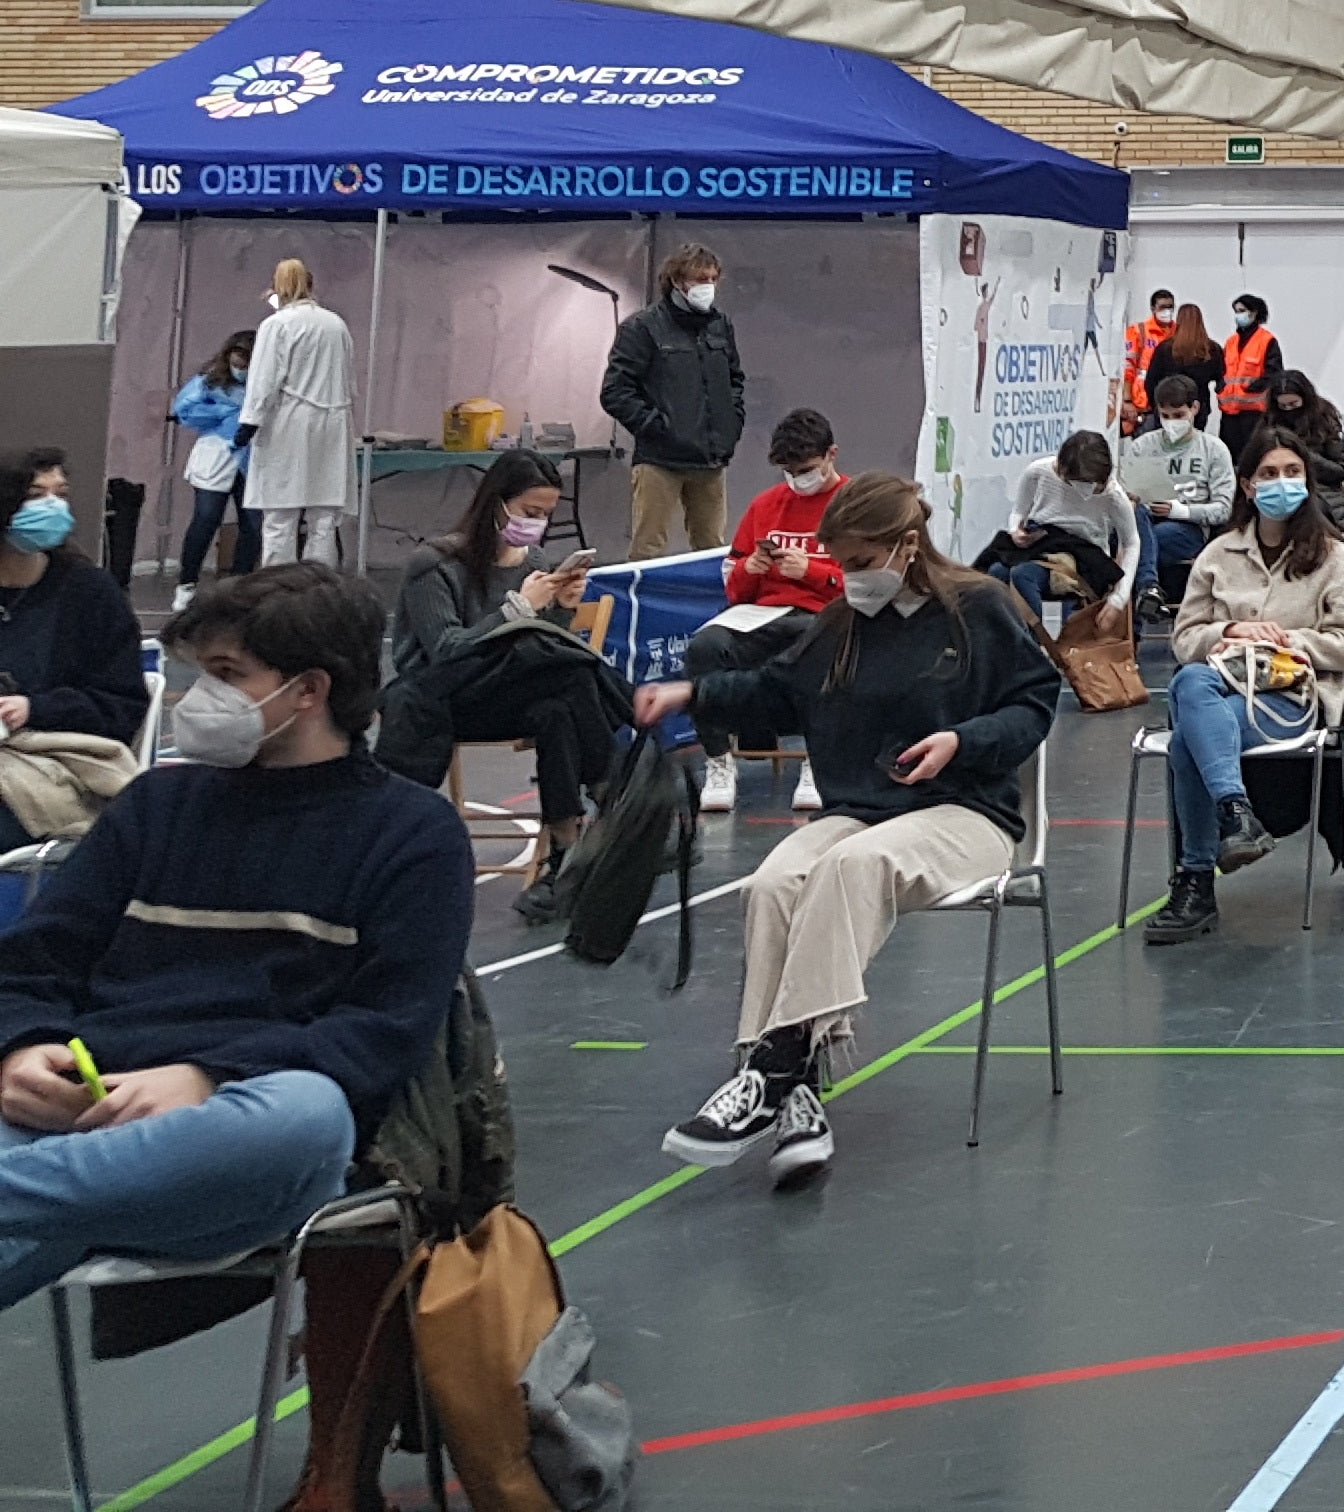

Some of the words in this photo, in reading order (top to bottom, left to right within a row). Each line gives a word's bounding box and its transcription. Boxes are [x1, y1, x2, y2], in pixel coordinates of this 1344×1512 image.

[376, 64, 744, 85] COMPROMETIDOS
[242, 79, 297, 96] ODS
[361, 88, 540, 104] Universidad
[540, 89, 578, 104] de
[582, 90, 717, 108] Zaragoza
[138, 164, 182, 195] LOS
[200, 162, 384, 195] OBJETIVOS
[402, 163, 449, 194] DE
[456, 164, 692, 197] DESARROLLO
[697, 165, 914, 199] SOSTENIBLE
[996, 343, 1080, 384] OBJETIVOS
[994, 391, 1009, 417] DE
[1012, 387, 1077, 417] DESARROLLO
